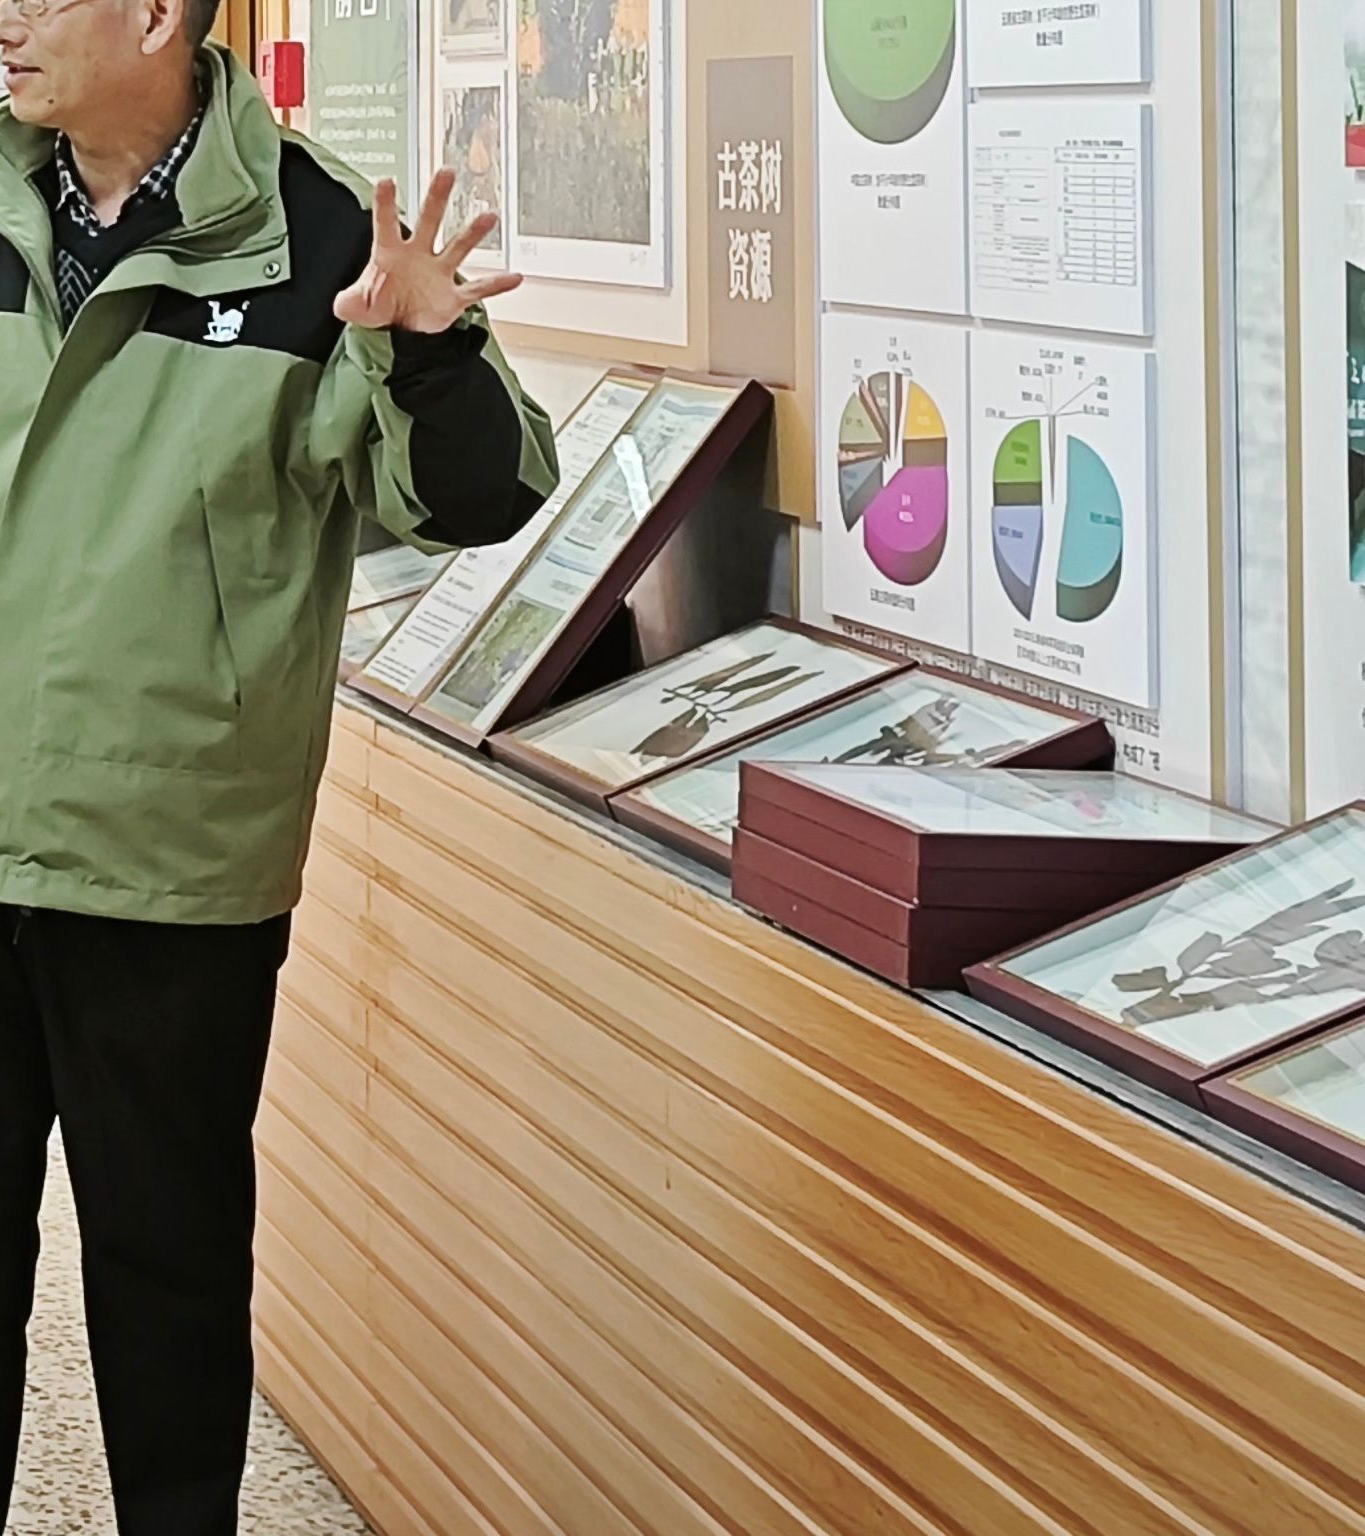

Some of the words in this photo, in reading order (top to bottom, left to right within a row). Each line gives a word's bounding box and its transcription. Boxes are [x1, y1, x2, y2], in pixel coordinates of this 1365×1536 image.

[716, 138, 783, 215] 古茶树
[727, 227, 774, 304] 资源
